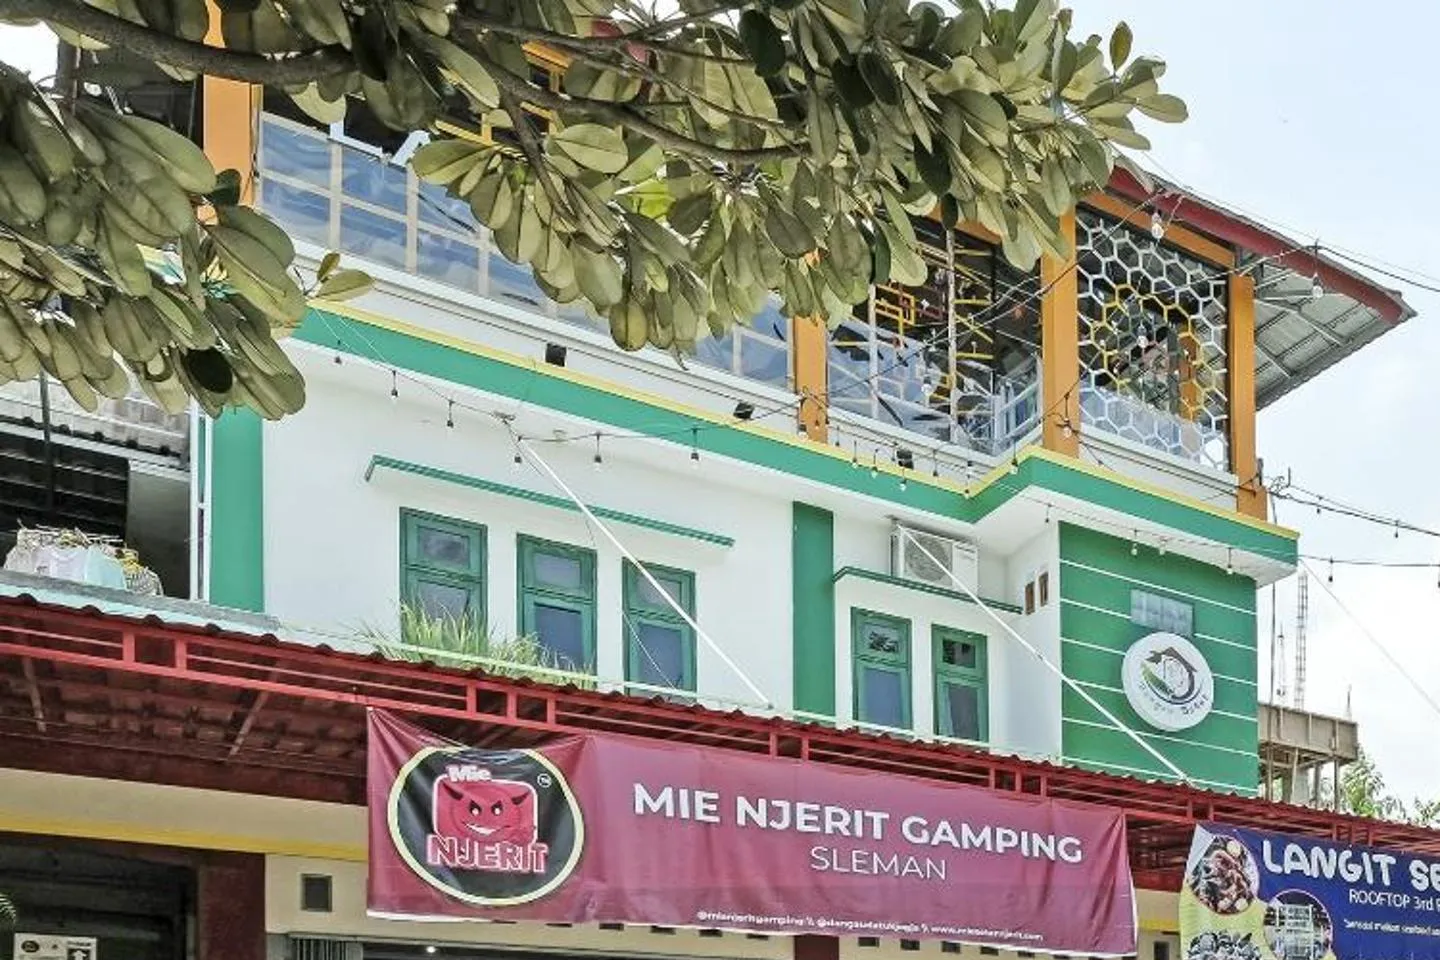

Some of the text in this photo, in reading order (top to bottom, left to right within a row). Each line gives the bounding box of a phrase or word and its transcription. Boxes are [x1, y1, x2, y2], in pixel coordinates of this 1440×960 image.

[447, 765, 493, 782] Mie
[633, 783, 1082, 863] MIE NJERIT GAMPING
[427, 834, 548, 873] NJERIT
[810, 846, 946, 881] SLEMAN
[1262, 839, 1396, 886] LANGIT
[1349, 889, 1410, 908] ROOFTOP
[1414, 898, 1433, 911] 3rd
